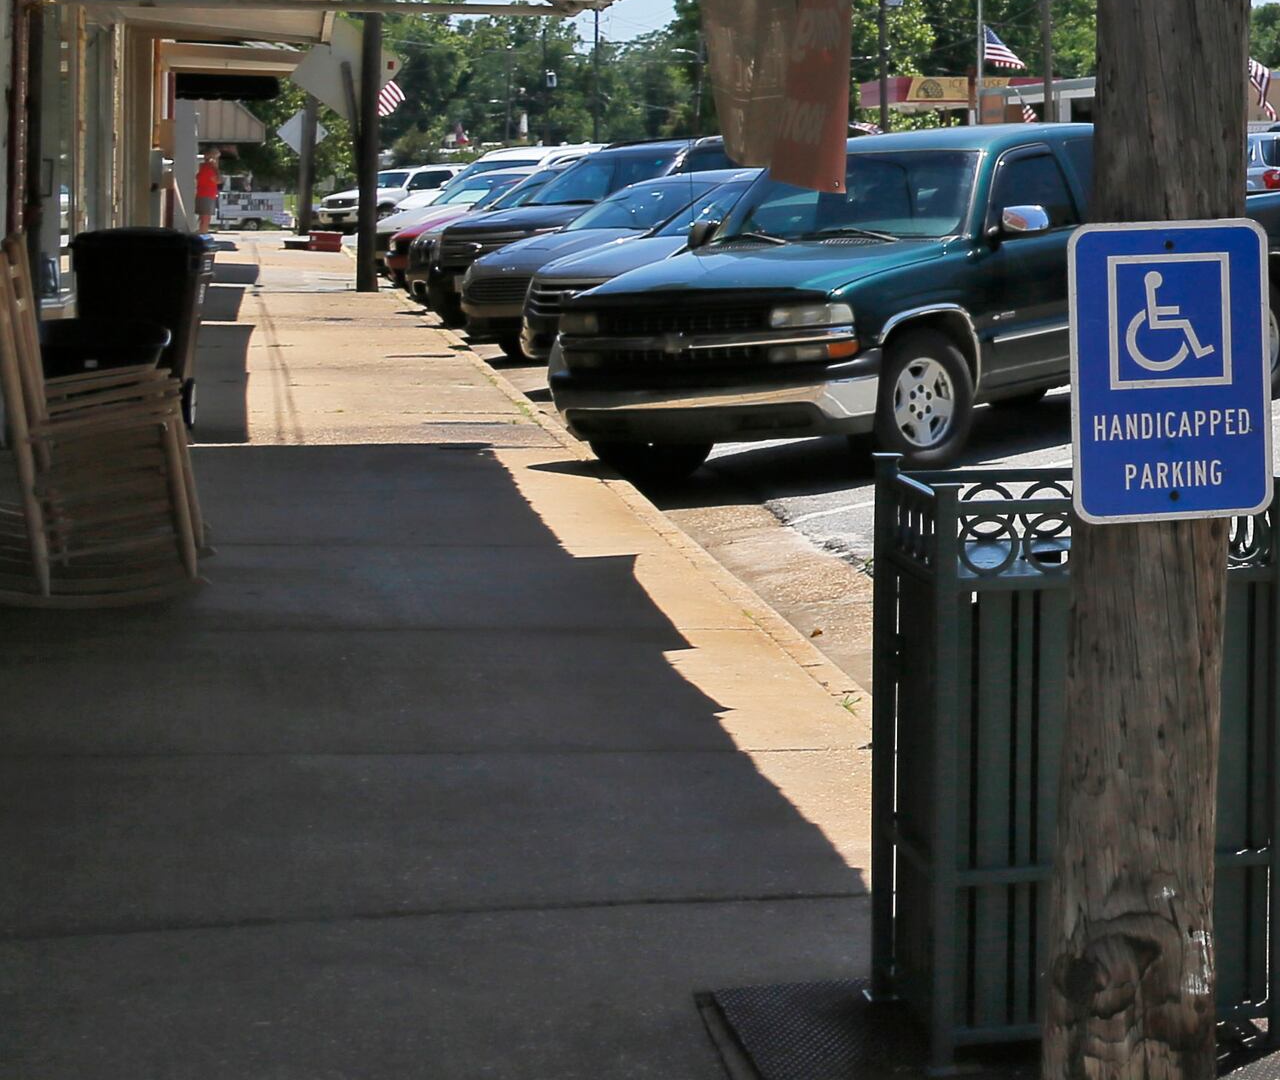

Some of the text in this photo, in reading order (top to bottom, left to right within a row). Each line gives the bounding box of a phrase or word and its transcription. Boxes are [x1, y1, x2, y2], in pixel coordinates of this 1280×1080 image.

[949, 79, 966, 88] ICE
[1093, 408, 1251, 442] HANDICAPPED
[1125, 459, 1223, 490] PARKING
